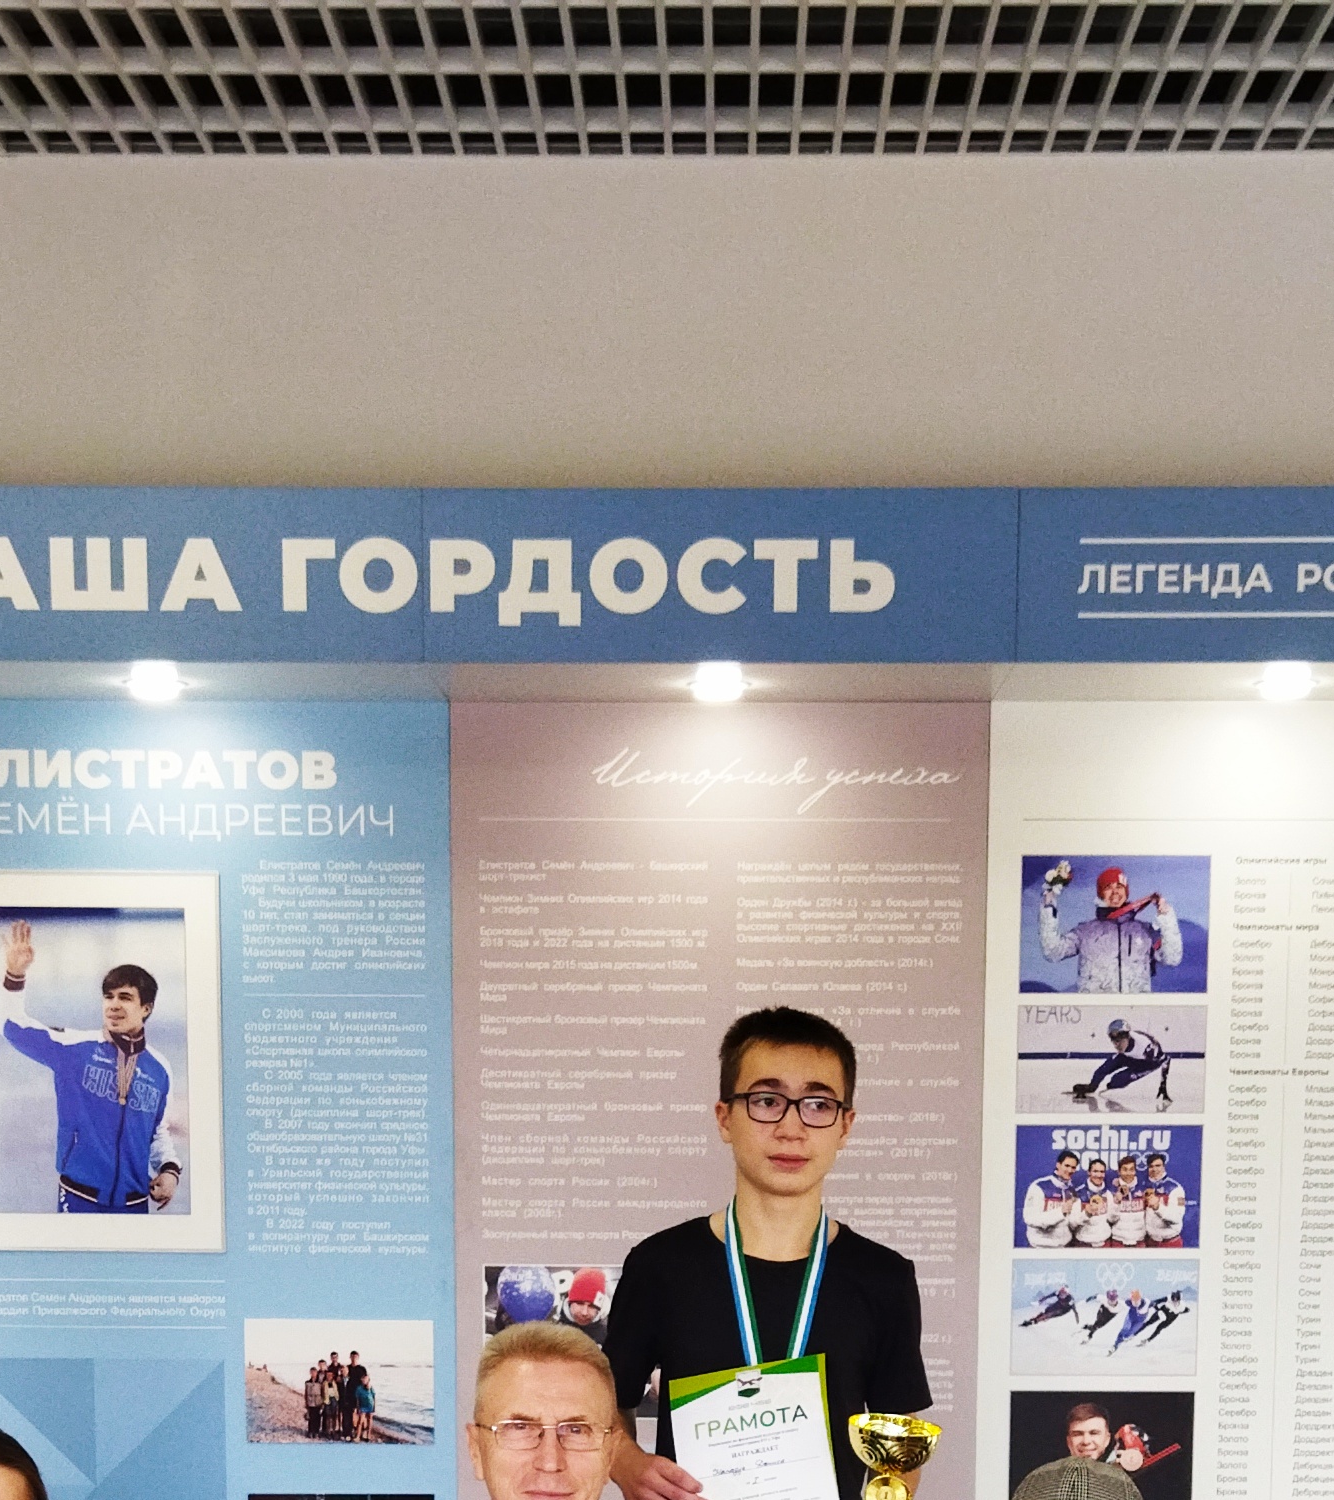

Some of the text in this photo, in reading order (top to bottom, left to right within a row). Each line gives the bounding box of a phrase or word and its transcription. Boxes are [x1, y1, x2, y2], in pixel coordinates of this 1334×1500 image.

[281, 536, 896, 627] ГОРДОСТЬ
[1079, 561, 1273, 599] ЛЕГЕНДА
[125, 803, 394, 843] АНДРЕЕВИЧ
[1052, 1125, 1171, 1150] sochi.ru
[694, 1405, 808, 1440] ГРАМОТА
